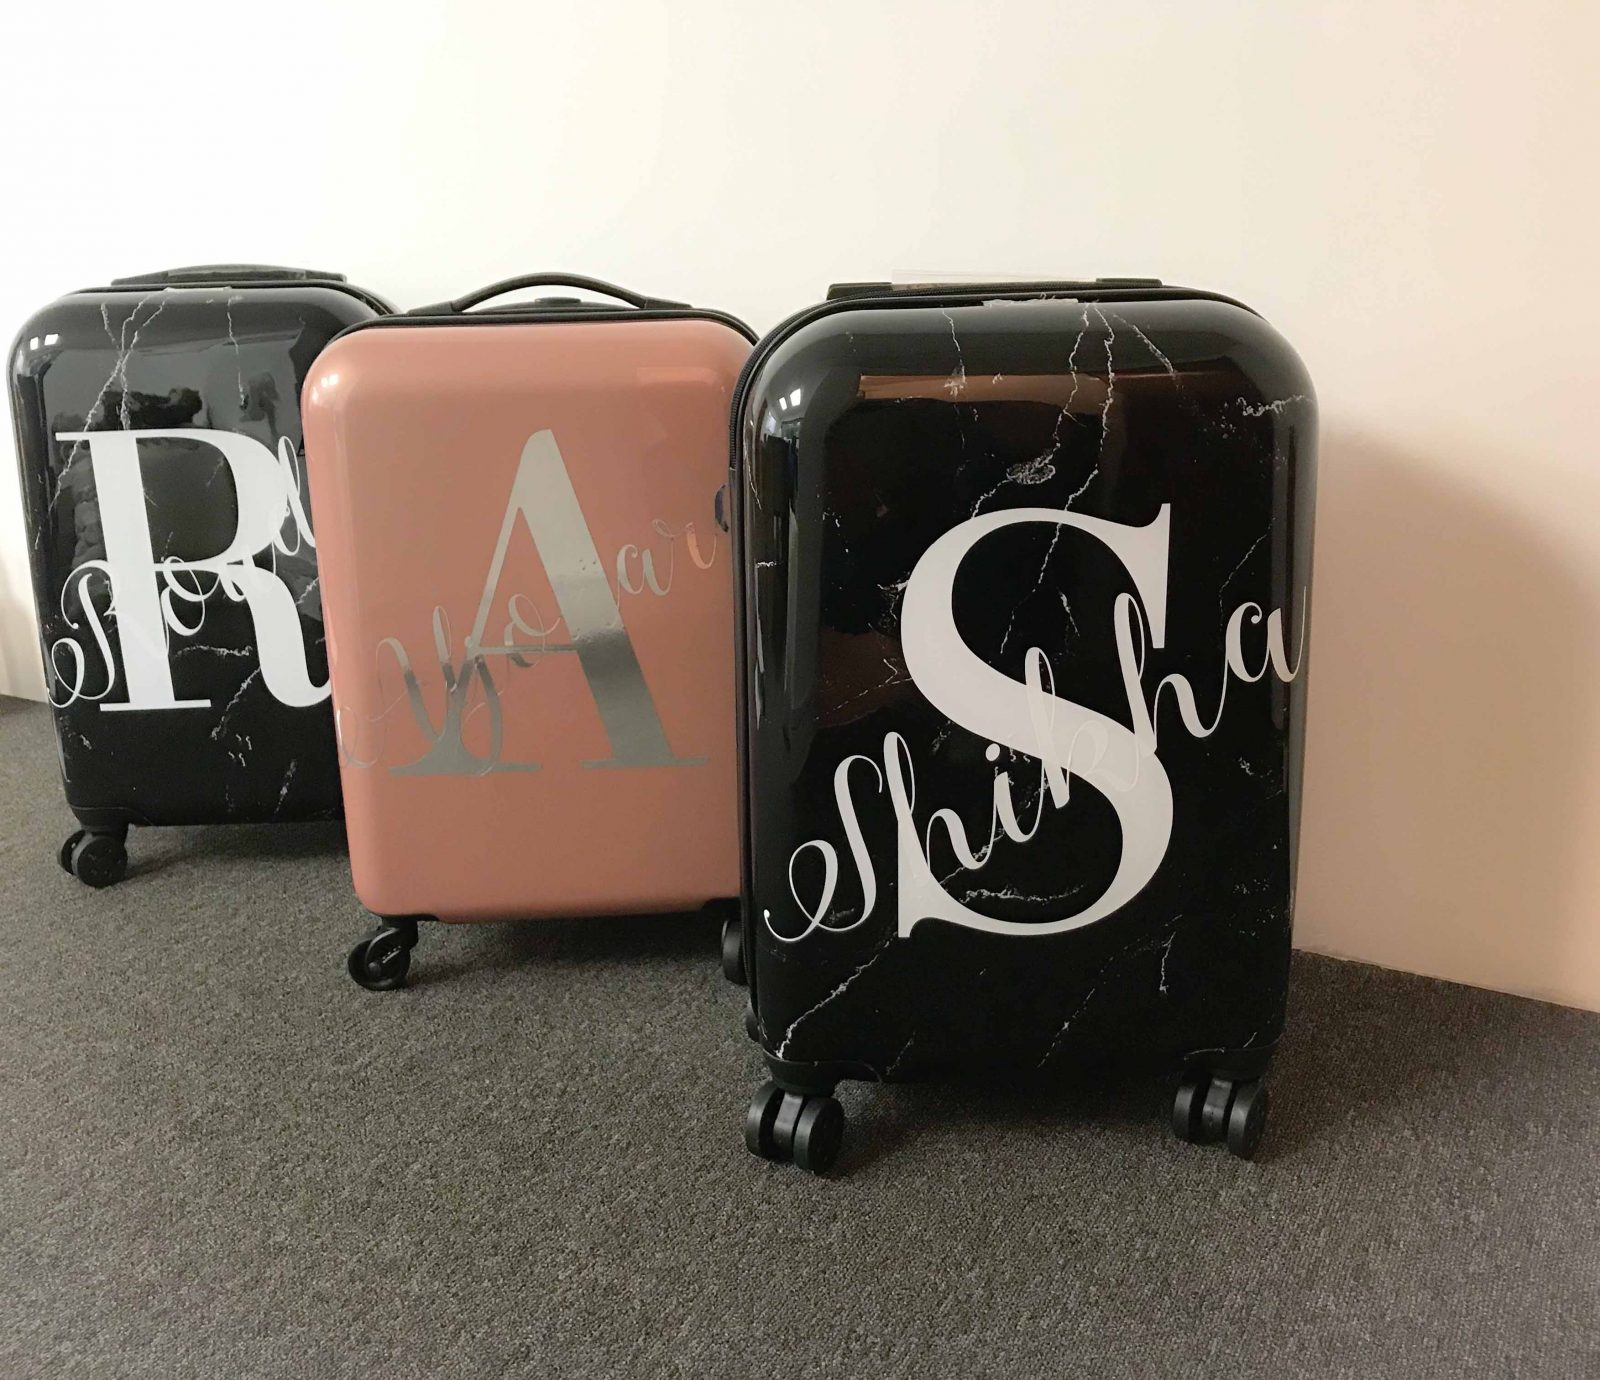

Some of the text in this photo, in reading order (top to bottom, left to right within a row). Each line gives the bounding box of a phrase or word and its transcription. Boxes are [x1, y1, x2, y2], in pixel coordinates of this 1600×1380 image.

[56, 428, 332, 711] R
[389, 429, 709, 776] A
[898, 503, 1173, 938] S
[764, 586, 1306, 942] Shikha
